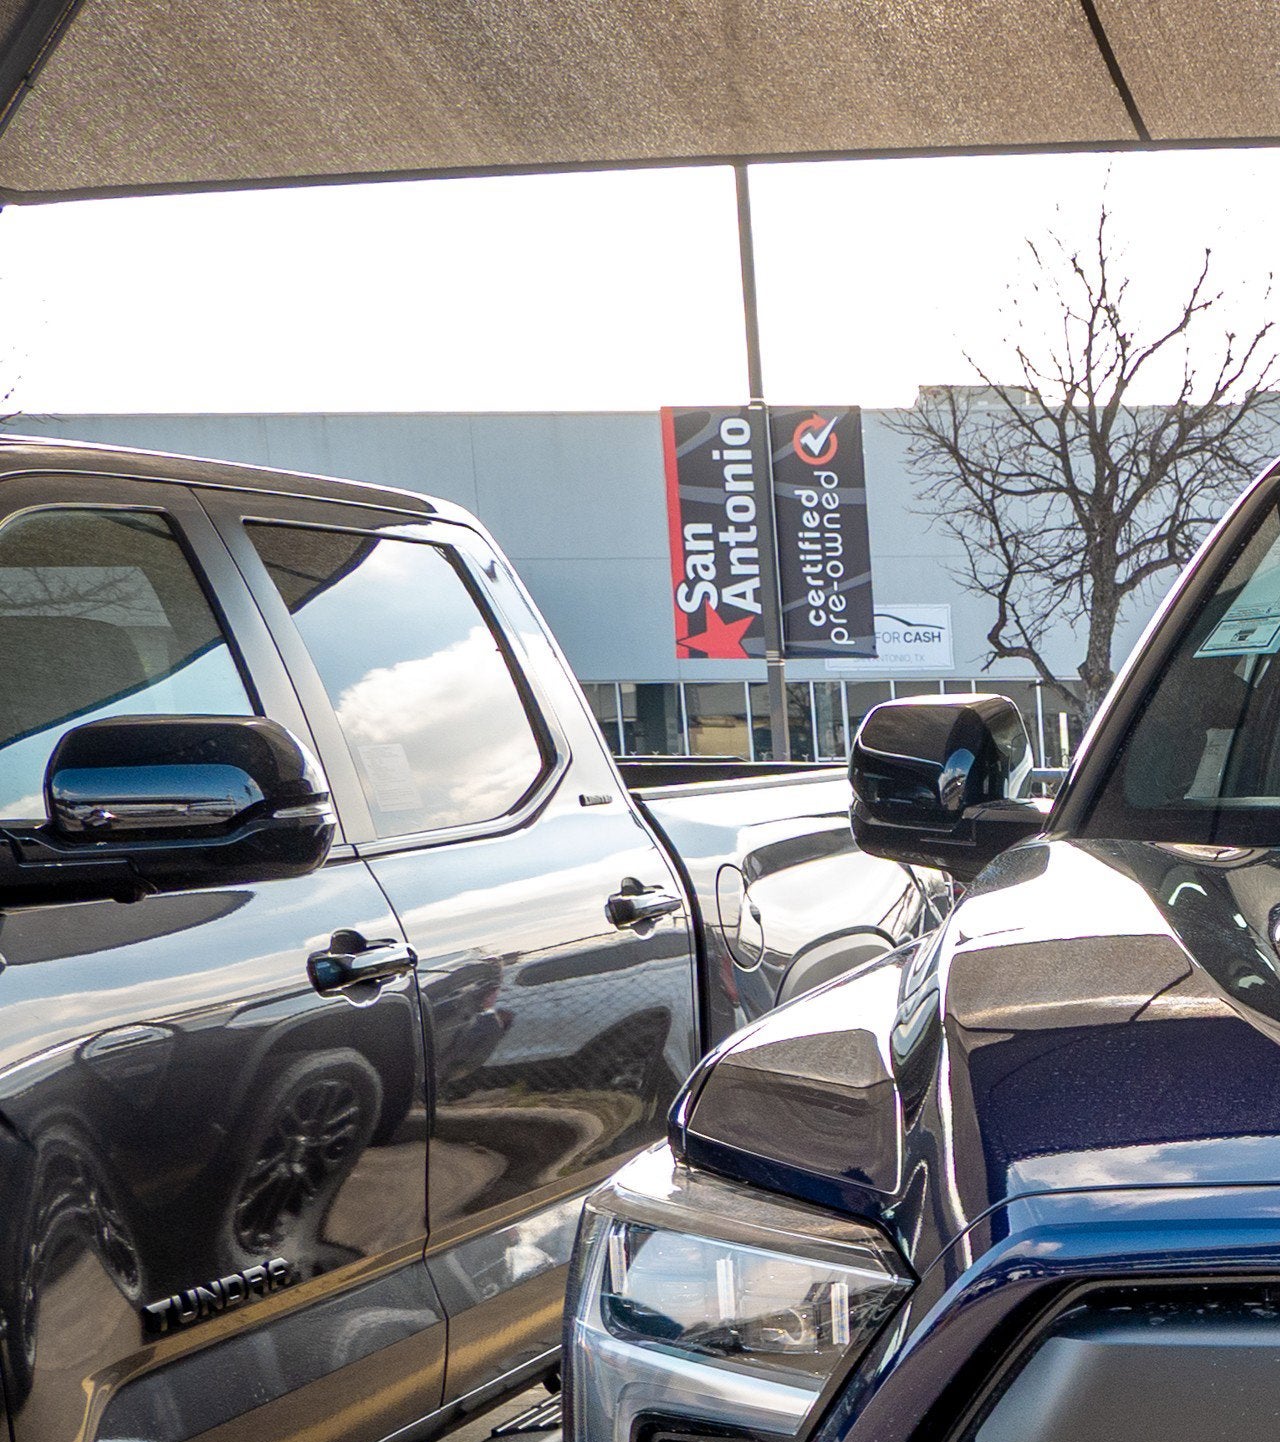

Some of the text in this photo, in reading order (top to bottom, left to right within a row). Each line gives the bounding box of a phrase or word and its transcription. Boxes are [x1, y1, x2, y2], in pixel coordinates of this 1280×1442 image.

[677, 523, 719, 614] San
[712, 417, 762, 614] Antonio
[794, 490, 827, 626] certified
[813, 470, 856, 645] pre-owned
[903, 631, 941, 643] CASH
[142, 1256, 292, 1333] TUNDRA
